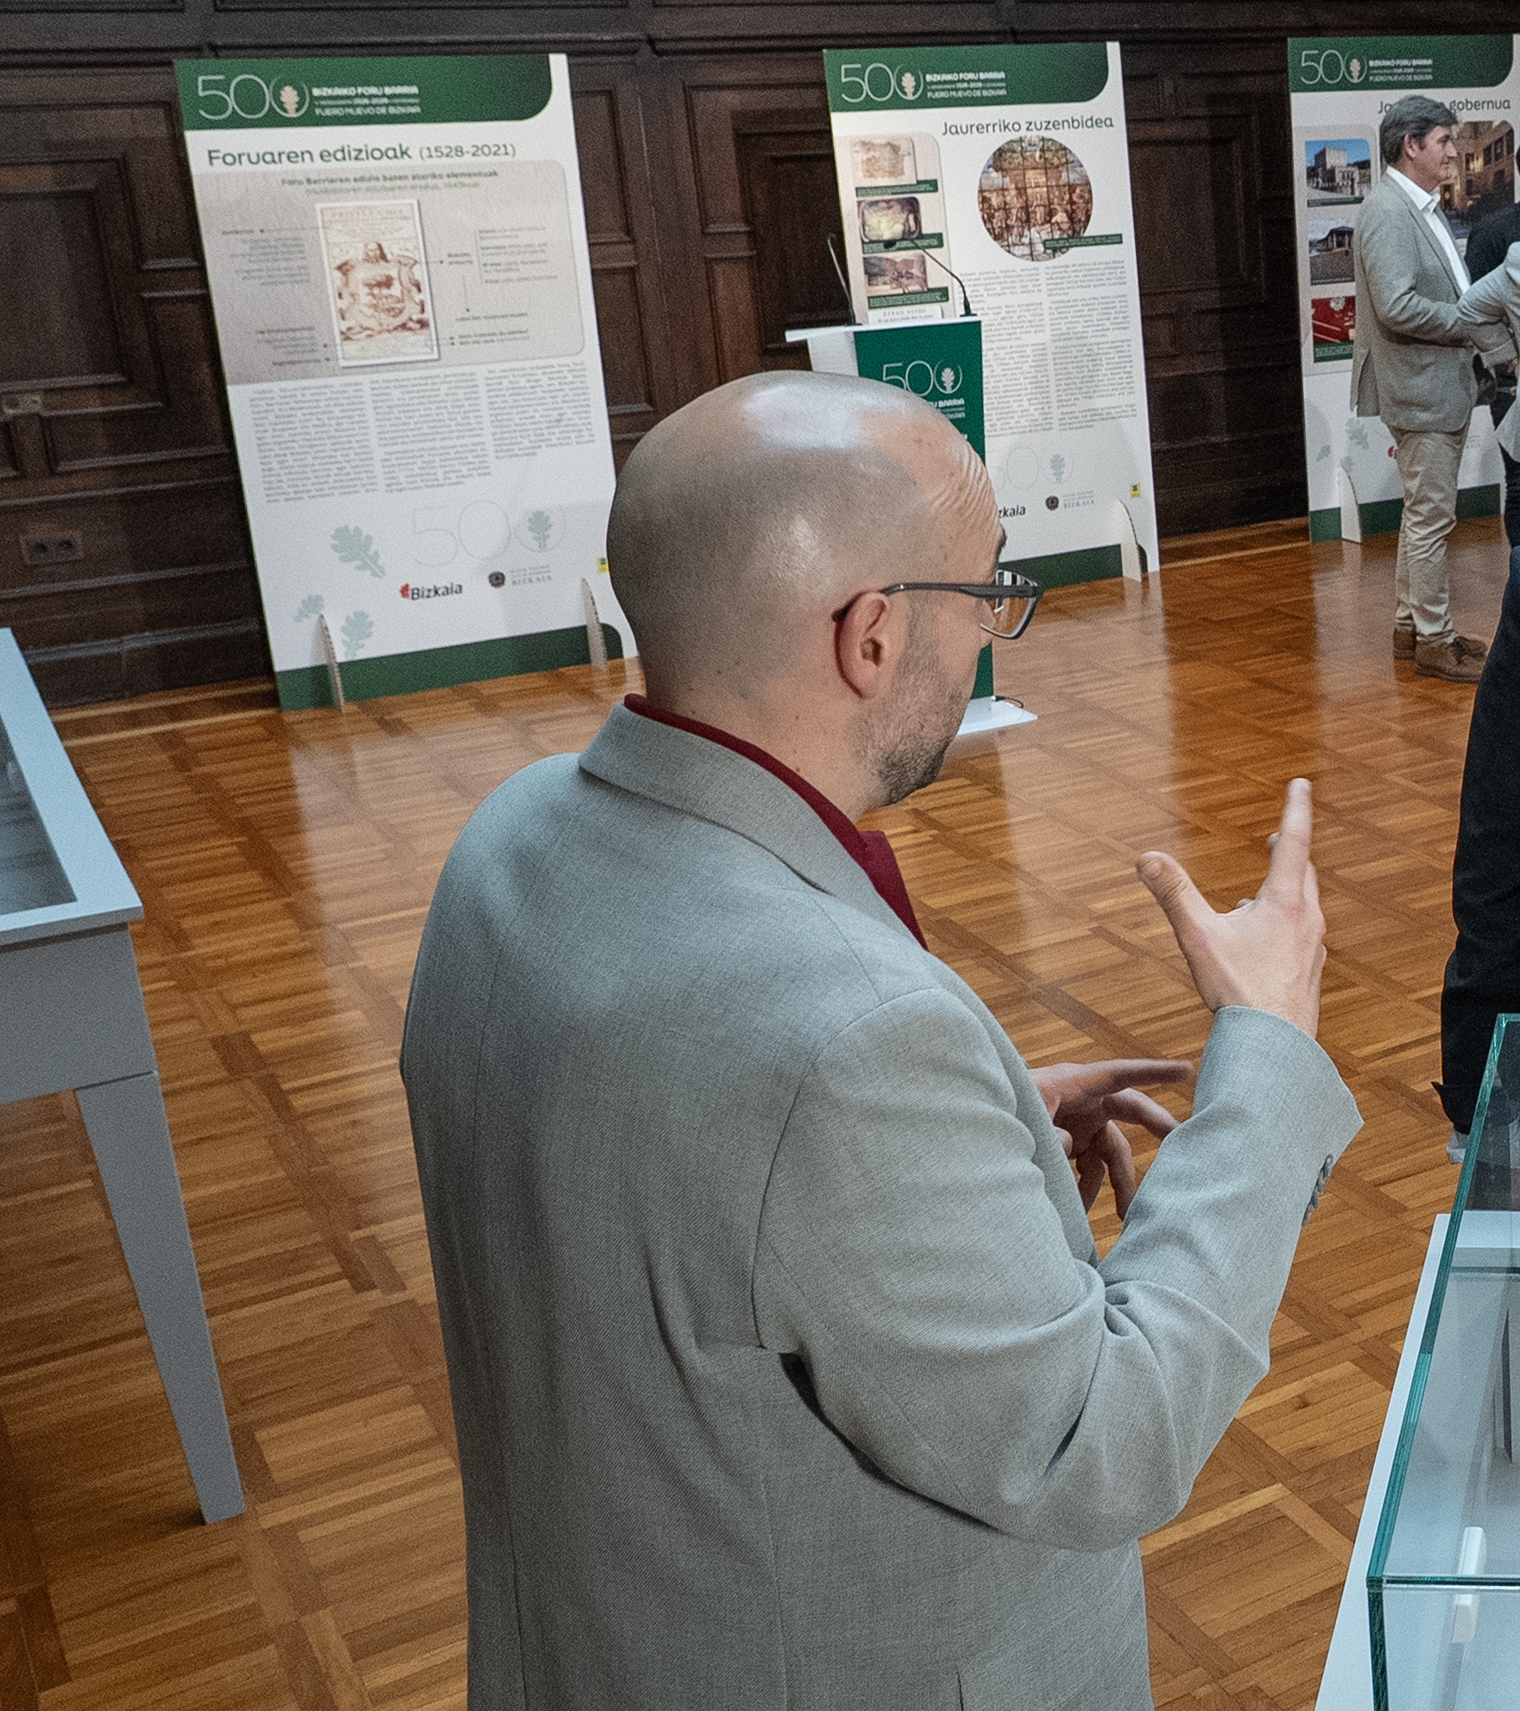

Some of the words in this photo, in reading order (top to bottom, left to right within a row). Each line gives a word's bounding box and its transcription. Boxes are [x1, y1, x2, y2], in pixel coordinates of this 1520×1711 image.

[1449, 99, 1511, 114] gobernua
[942, 119, 1022, 136] Jaurerriko
[1025, 115, 1114, 132] zuzenbidea
[207, 148, 315, 167] Foruaren
[320, 142, 413, 163] edizioak
[419, 142, 517, 161] (1528-2021)
[998, 504, 1026, 519] zkaia
[410, 582, 463, 601] Bizkaia
